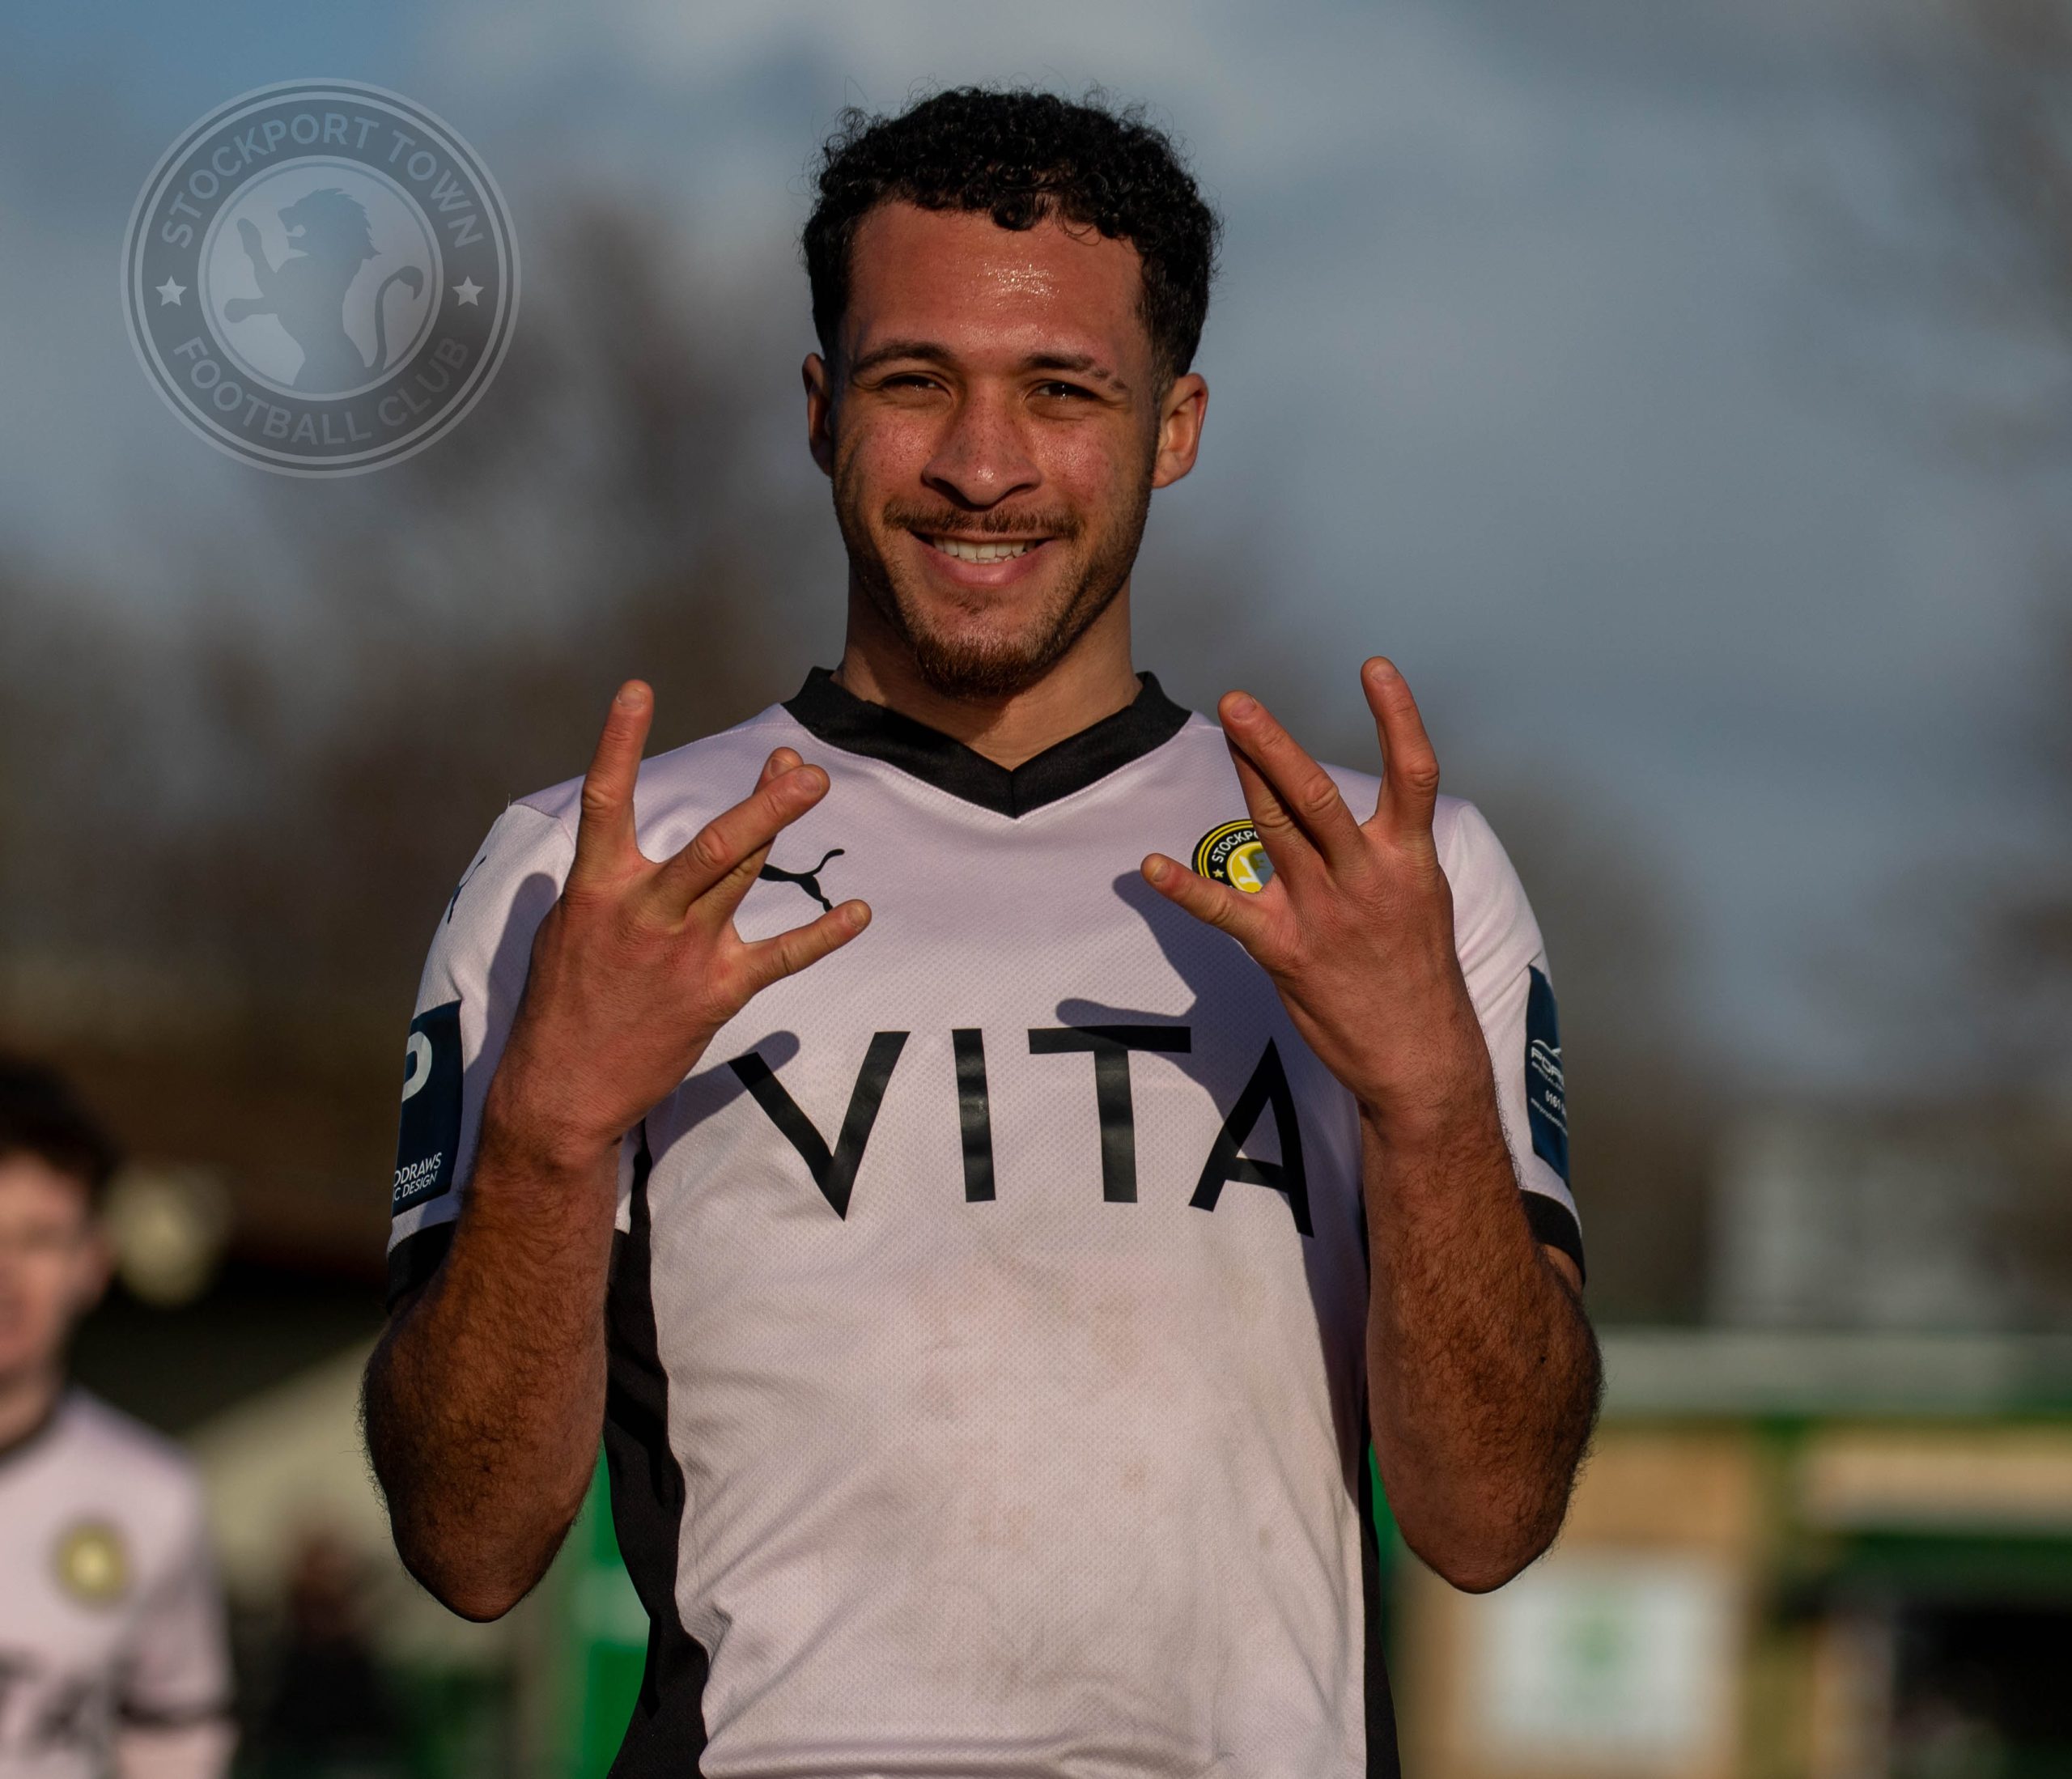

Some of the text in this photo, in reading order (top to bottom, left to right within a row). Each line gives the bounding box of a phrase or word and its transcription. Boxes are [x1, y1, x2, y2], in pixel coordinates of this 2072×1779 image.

[1211, 830, 1259, 864] STOCKP
[727, 1025, 1315, 1238] VITA
[402, 1170, 438, 1198] DESIGN
